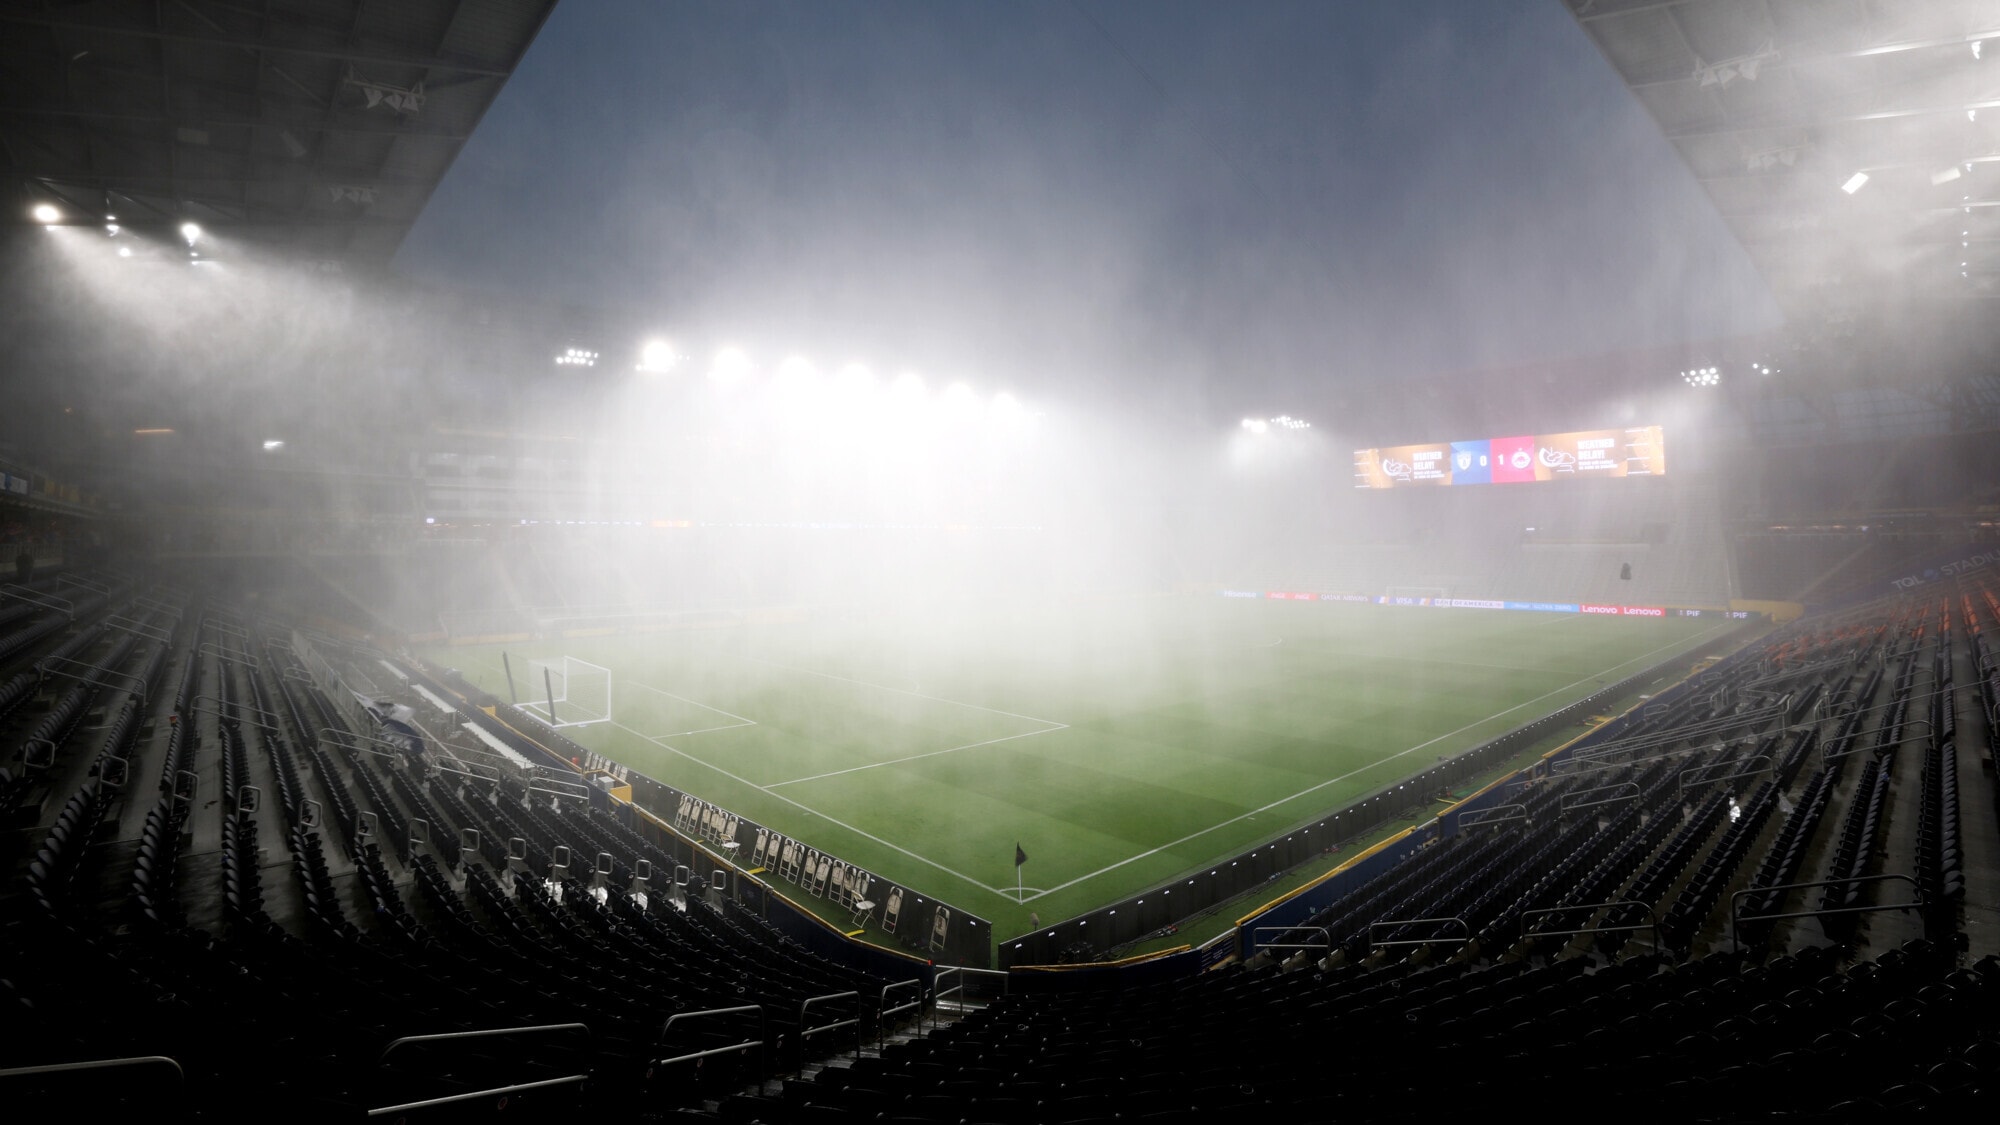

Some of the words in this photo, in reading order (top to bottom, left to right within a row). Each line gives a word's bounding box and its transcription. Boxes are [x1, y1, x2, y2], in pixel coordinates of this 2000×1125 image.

[1577, 438, 1615, 449] WEATHER
[1413, 451, 1442, 461] WEATHER
[1577, 450, 1605, 460] DELAY!
[1479, 455, 1487, 467] 0
[1497, 454, 1504, 465] 1
[1891, 575, 1925, 590] TQL
[1223, 590, 1257, 598] Hisense
[1342, 594, 1368, 602] AIRWAYS
[1582, 605, 1618, 614] Lenovo
[1623, 606, 1662, 616] Lenovo
[1732, 611, 1748, 619] PIF
